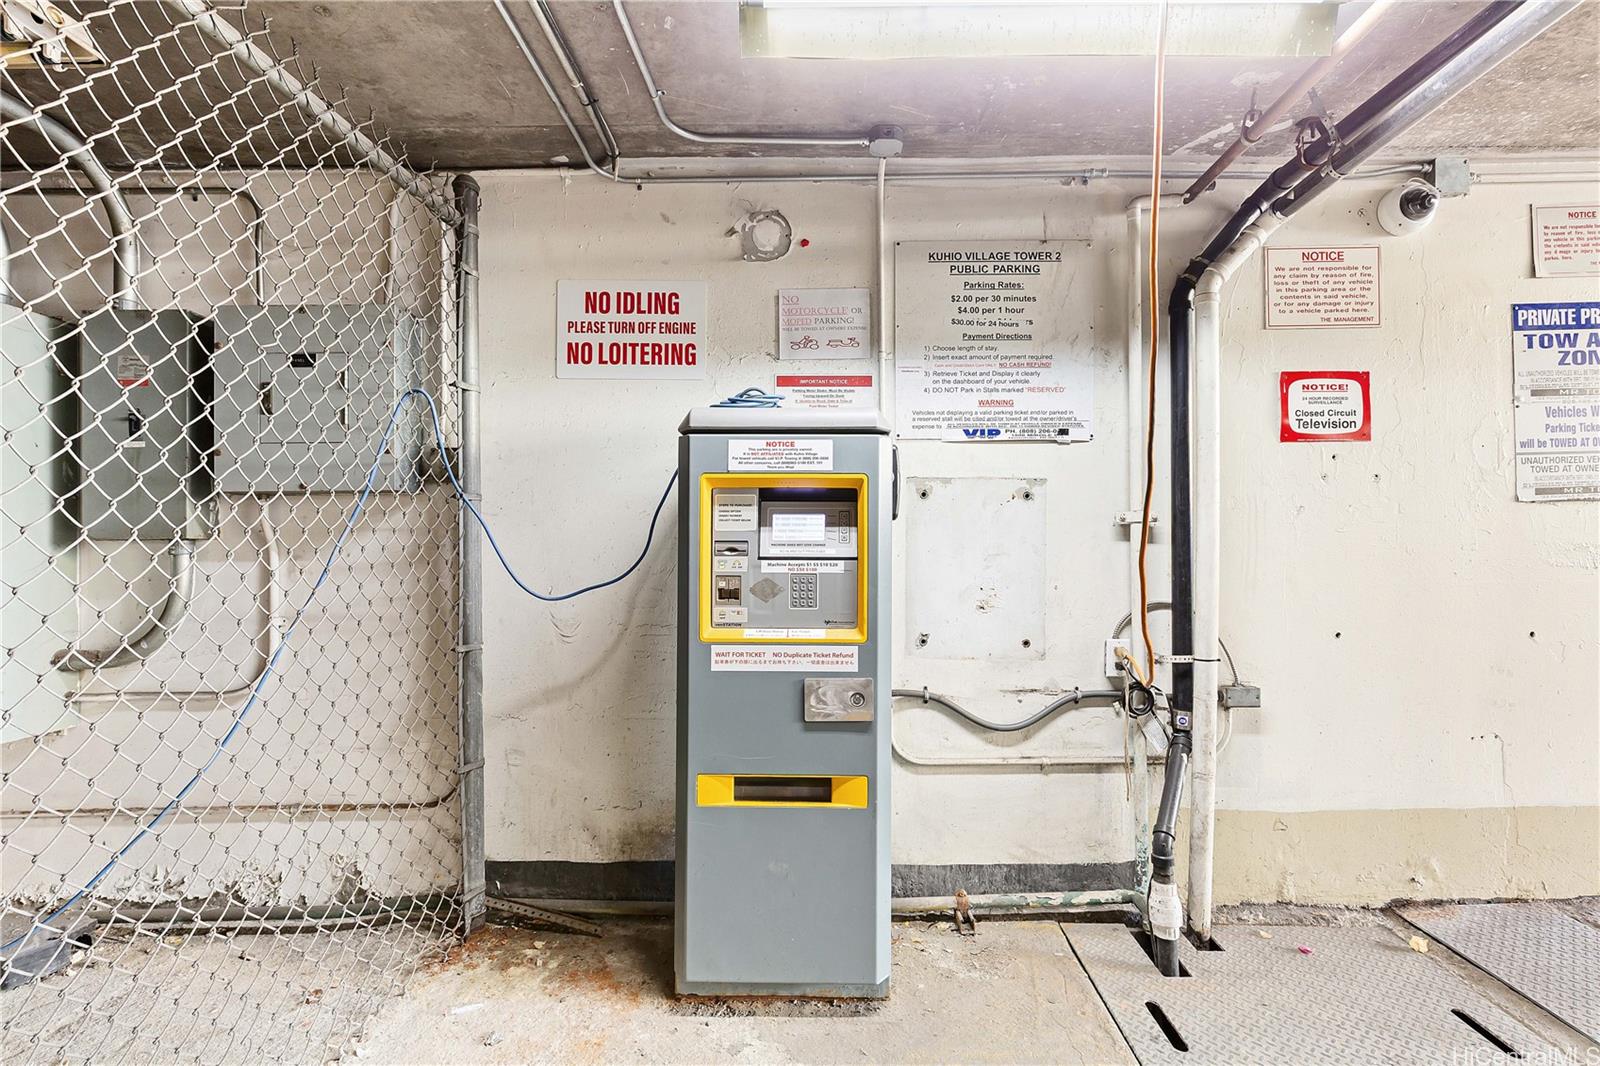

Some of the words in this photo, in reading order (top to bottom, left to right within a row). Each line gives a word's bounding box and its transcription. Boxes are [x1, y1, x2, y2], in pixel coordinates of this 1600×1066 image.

[1568, 211, 1597, 219] NOTICE
[929, 251, 962, 261] KUHIO
[965, 251, 1010, 261] VILLAGE
[1014, 251, 1051, 261] TOWER
[1055, 252, 1061, 261] 2
[1302, 251, 1344, 261] NOTICE
[950, 264, 988, 274] PUBLIC
[993, 264, 1040, 274] PARKING
[964, 281, 995, 290] Parking
[998, 281, 1024, 289] Rates:
[585, 291, 610, 314] NO
[616, 292, 679, 314] IDLING
[782, 295, 799, 304] NO
[951, 295, 973, 303] $2.00
[975, 296, 988, 304] per
[991, 295, 1001, 303] 30
[1003, 295, 1037, 303] minutes
[782, 307, 848, 315] MOTORCYCLE
[958, 306, 979, 315] $4.00
[982, 307, 995, 315] per
[998, 306, 1002, 314] 1
[1005, 306, 1024, 314] hour
[815, 317, 854, 325] PARKING!
[1518, 309, 1576, 326] PRIVATE
[567, 321, 606, 334] PLEASE
[608, 322, 635, 334] TURN
[638, 322, 656, 334] OFF
[659, 322, 696, 334] ENGINE
[951, 318, 975, 327] $30.00
[988, 320, 997, 328] 24
[998, 320, 1019, 328] hours
[962, 332, 994, 341] Payment
[996, 332, 1032, 340] Directions
[1523, 333, 1578, 349] TOW
[957, 345, 976, 353] length
[985, 345, 999, 353] stay.
[567, 343, 592, 365] NO
[599, 343, 696, 366] LOITERING
[1000, 354, 1026, 362] payment
[992, 370, 1014, 378] Display
[1021, 370, 1040, 378] clearly
[978, 399, 1014, 407] WARNING
[1295, 409, 1324, 417] Closed
[1327, 409, 1356, 417] Circuit
[1545, 406, 1587, 418] Vehicles
[1296, 419, 1357, 429] Television
[1545, 423, 1576, 434] Parking
[963, 429, 1001, 439] VIP
[1520, 438, 1534, 449] will
[1537, 438, 1547, 448] be
[1550, 438, 1577, 448] TOWED
[1580, 437, 1590, 447] AT
[1521, 456, 1584, 465] UNAUTHORIZED
[1530, 465, 1559, 473] TOWED
[1562, 465, 1572, 473] AT
